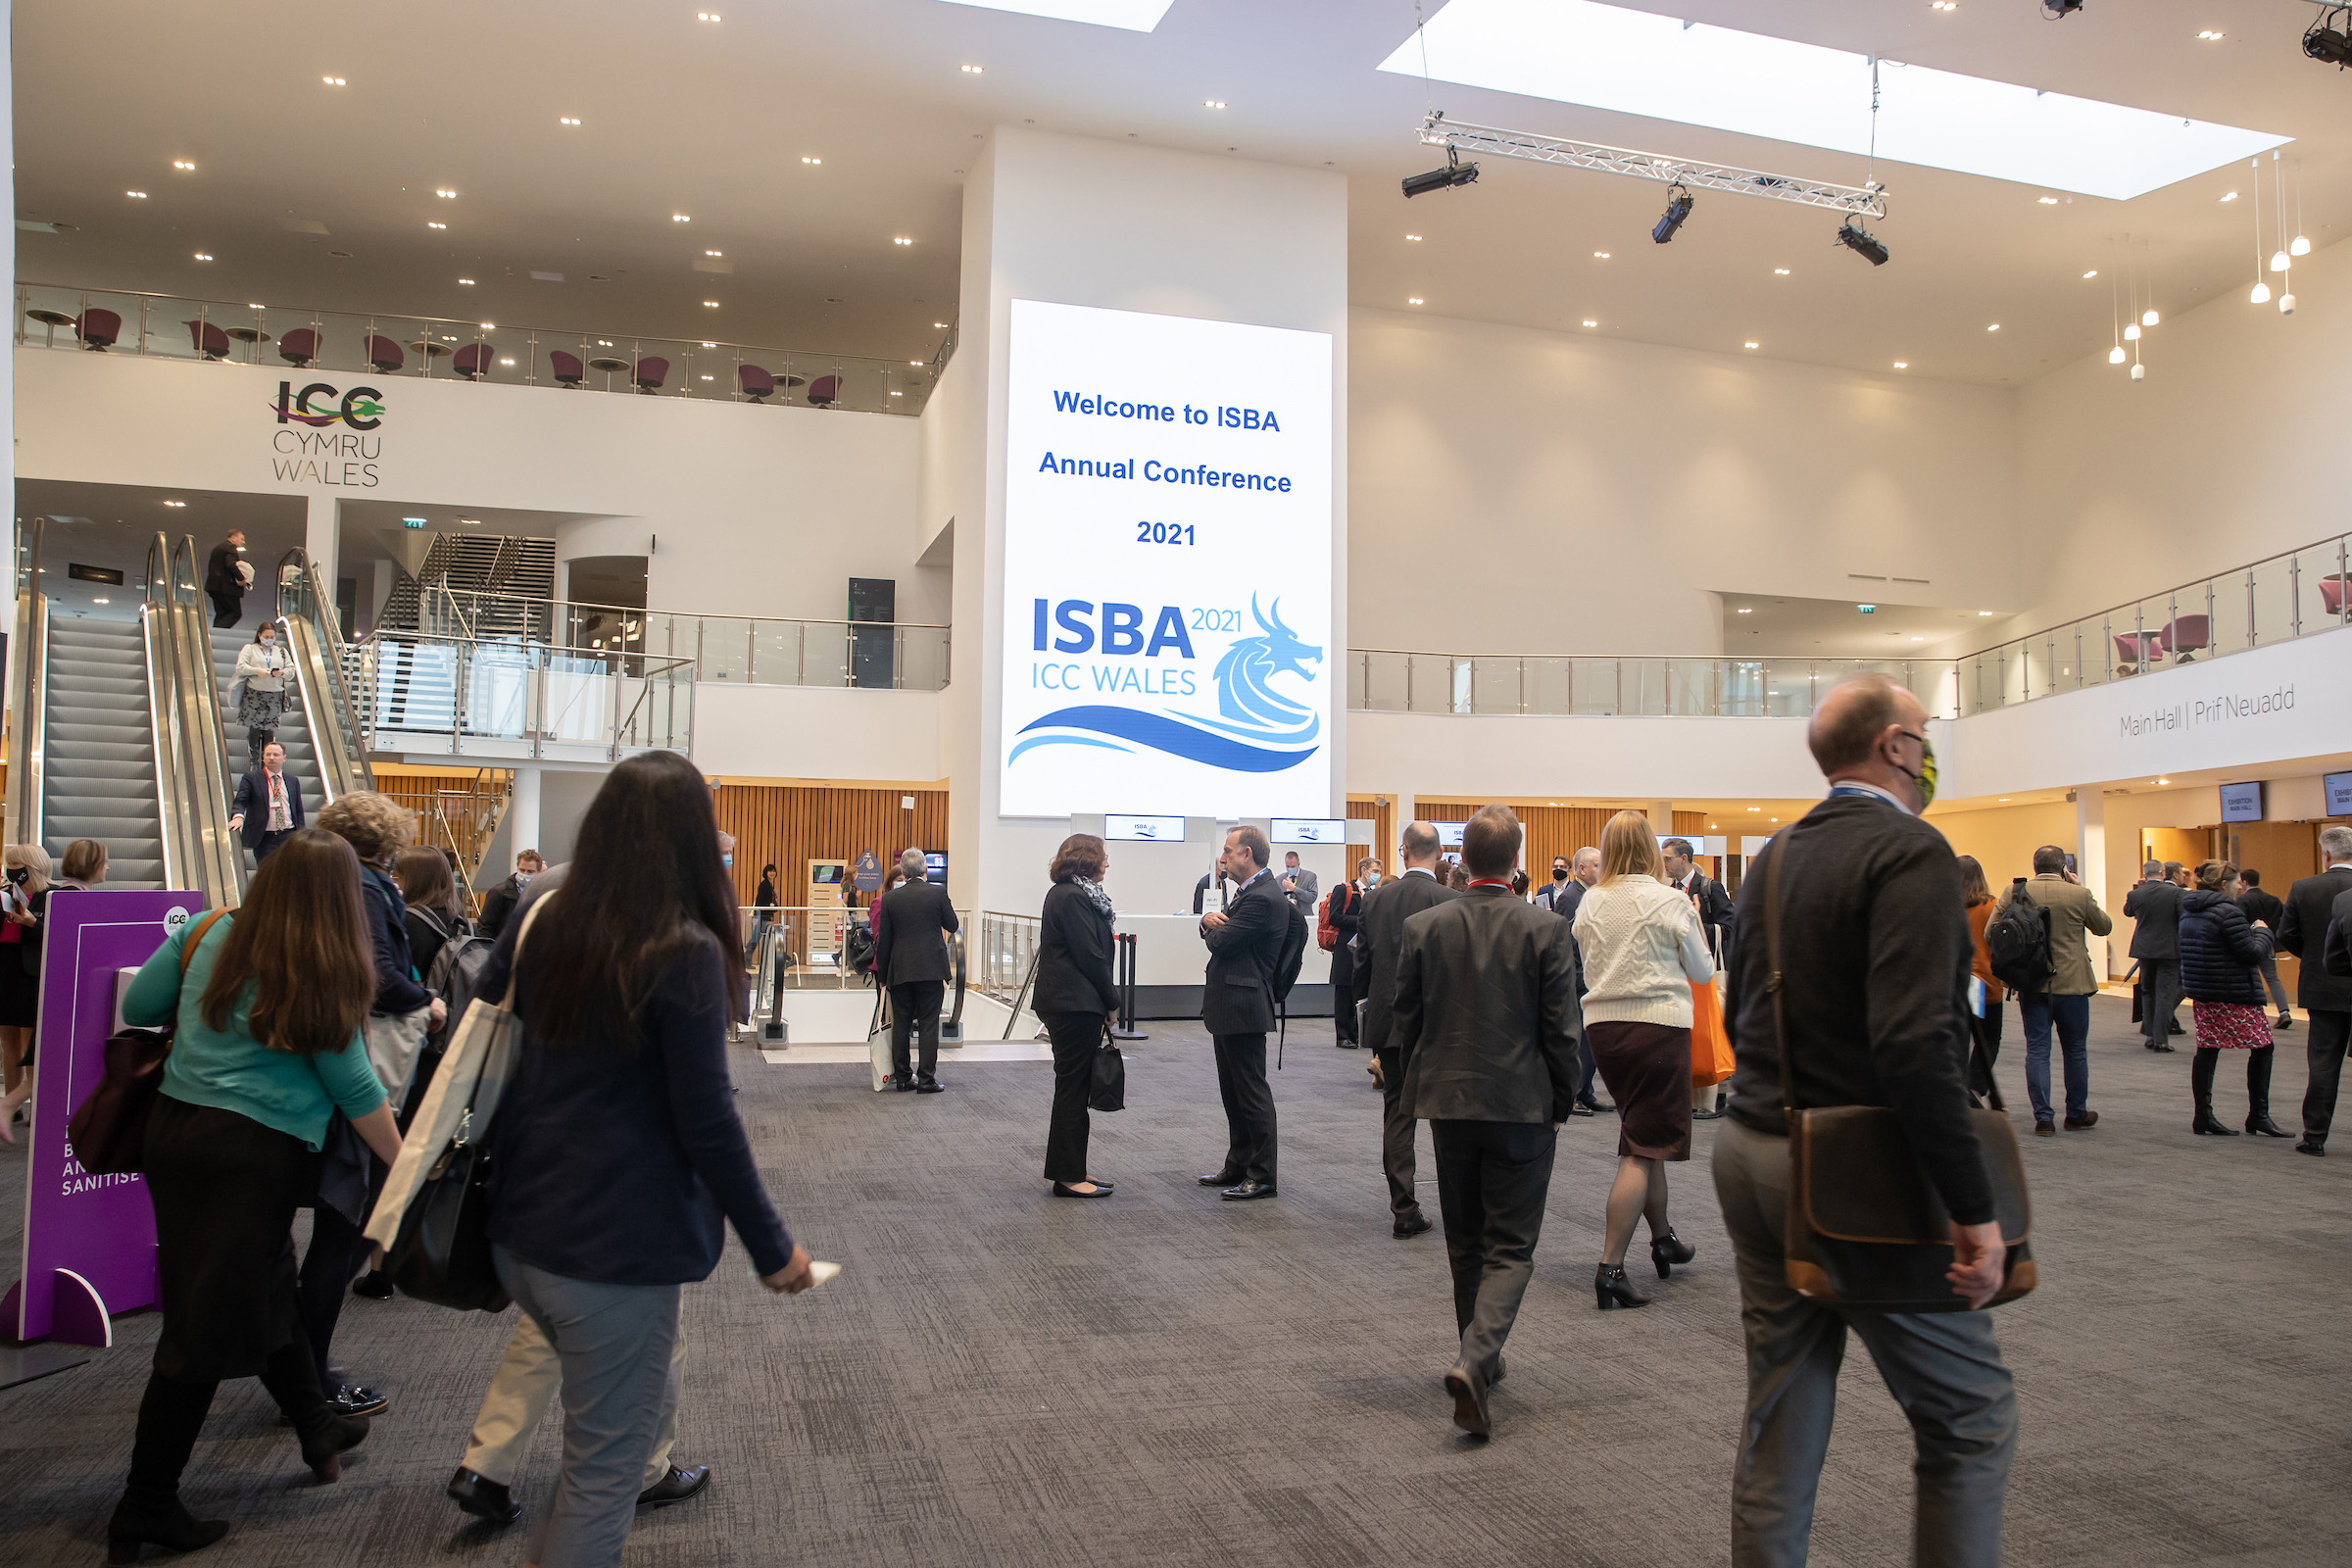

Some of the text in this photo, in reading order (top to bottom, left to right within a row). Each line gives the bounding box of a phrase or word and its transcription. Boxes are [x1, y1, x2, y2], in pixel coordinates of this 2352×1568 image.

[277, 380, 383, 431] ICC
[1054, 390, 1281, 432] Welcome to ISBA
[273, 429, 381, 460] CYMRU
[272, 458, 379, 488] WALES
[1039, 452, 1292, 493] Annual Conference
[1137, 521, 1195, 546] 2021
[1033, 598, 1242, 660] ISBA 2021
[1033, 662, 1197, 696] ICC WALES
[2120, 714, 2152, 737] Main
[2155, 705, 2181, 731] Hall
[2195, 697, 2223, 725] Prif
[2226, 682, 2295, 719] Neuadd
[169, 914, 186, 924] ICC
[62, 1160, 86, 1177] AN
[62, 1172, 139, 1196] SANITISE
